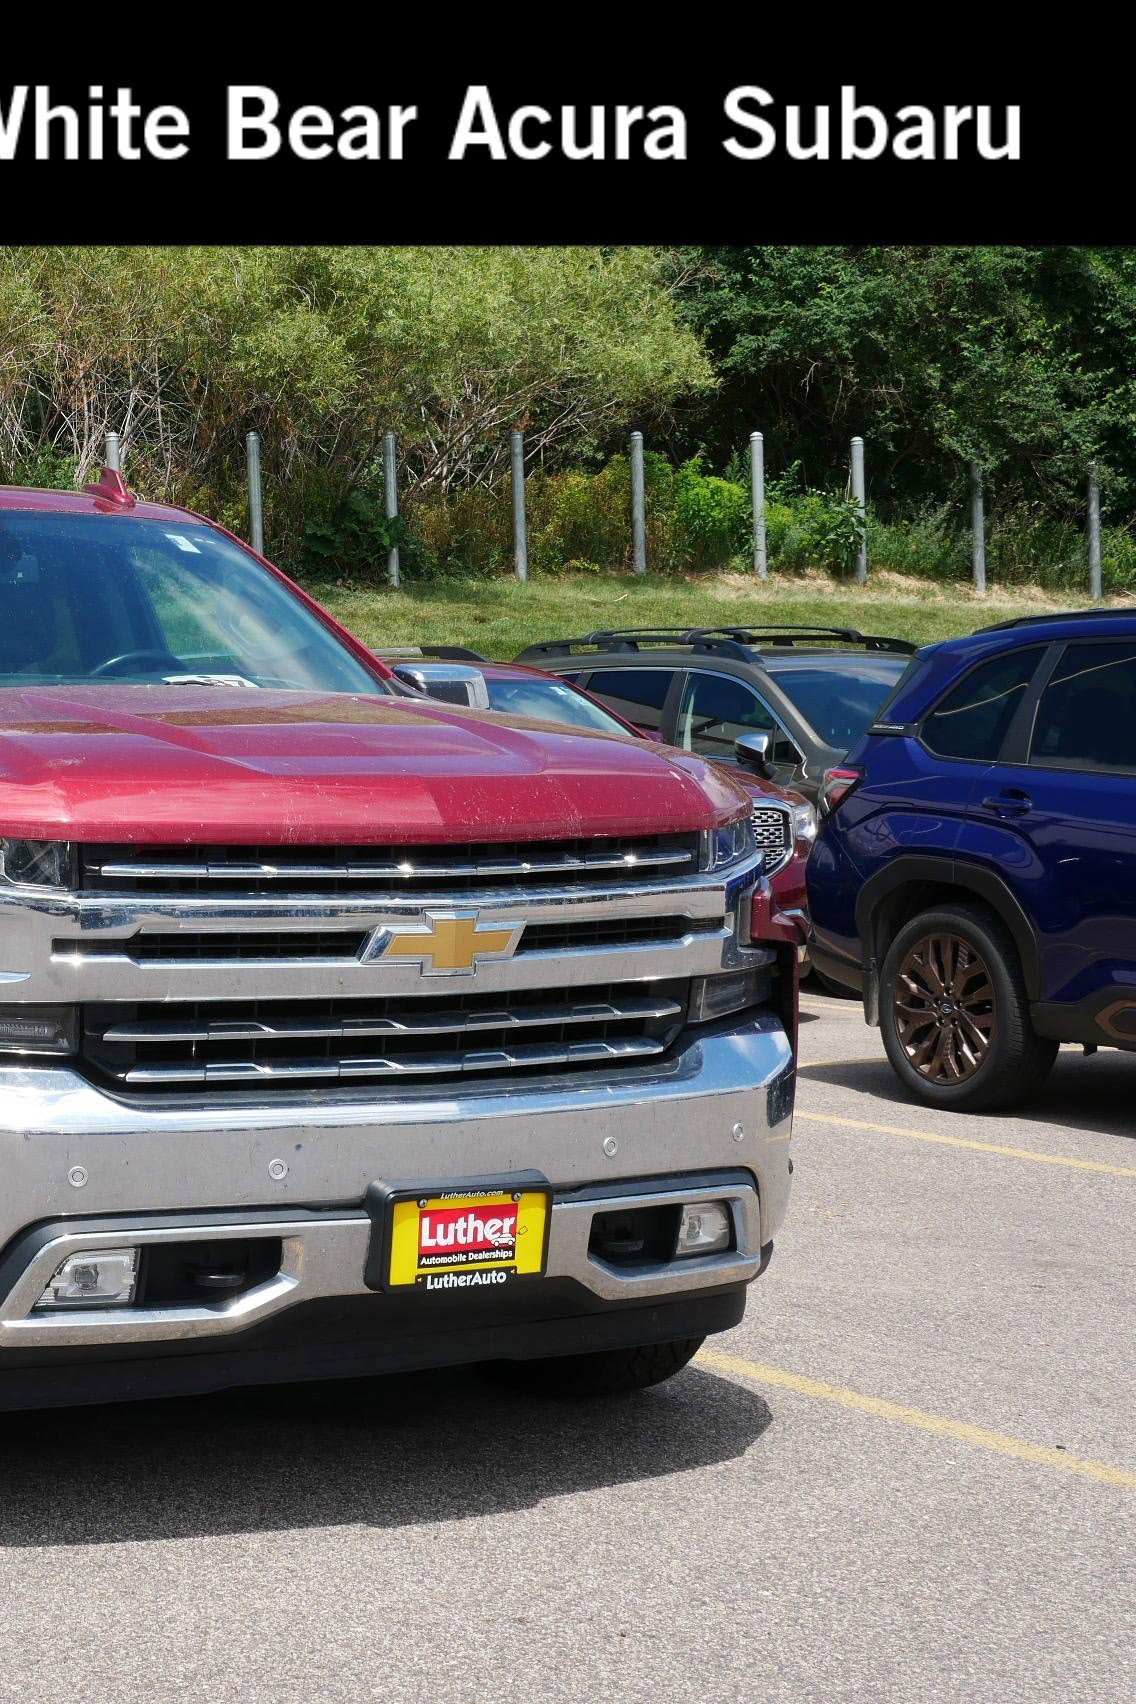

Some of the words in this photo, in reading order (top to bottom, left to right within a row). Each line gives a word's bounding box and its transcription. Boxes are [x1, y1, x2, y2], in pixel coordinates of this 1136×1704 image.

[440, 1190, 504, 1200] LutherAuto.com
[421, 1213, 516, 1247] Luther
[420, 1253, 467, 1266] Automobile
[468, 1248, 513, 1261] Dealerships
[426, 1270, 507, 1290] LutherAuto
